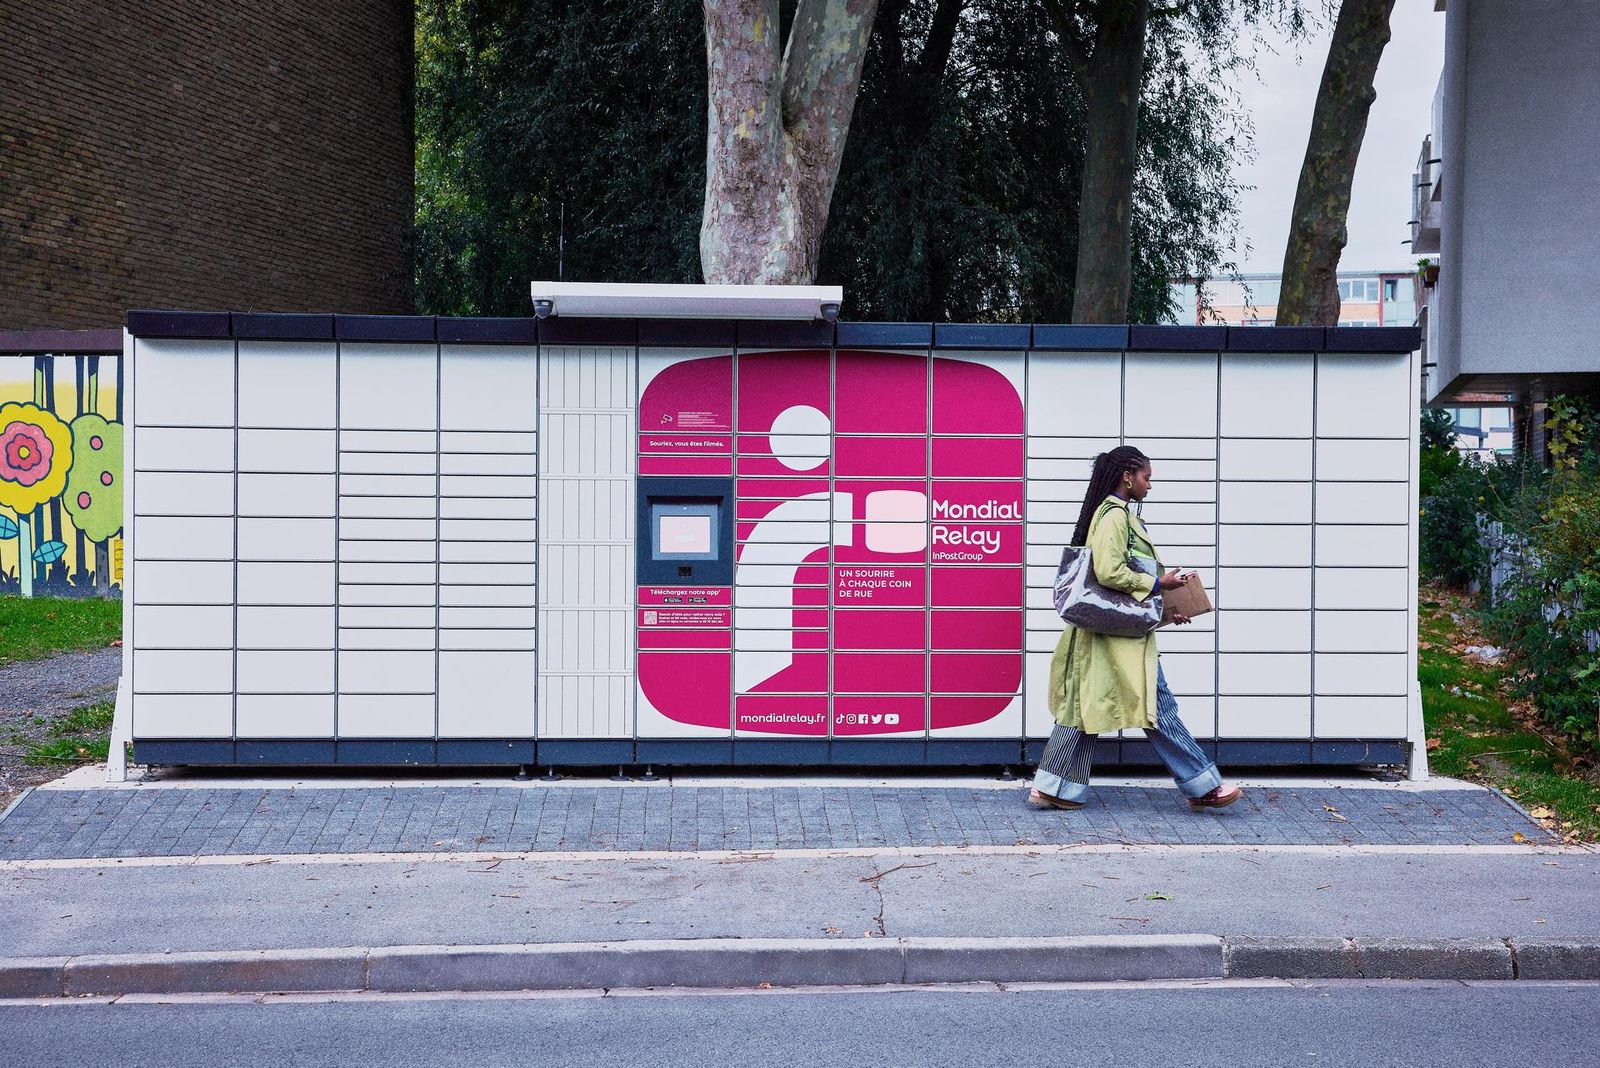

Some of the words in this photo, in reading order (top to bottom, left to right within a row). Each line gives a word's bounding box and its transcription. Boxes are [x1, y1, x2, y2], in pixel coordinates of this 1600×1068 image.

[932, 500, 1022, 518] Mondial
[932, 526, 1000, 554] Relay
[932, 552, 984, 562] InPostGroup
[839, 578, 846, 588] À
[848, 580, 887, 588] CHAQUE
[740, 714, 826, 724] mondialrelay.fr
